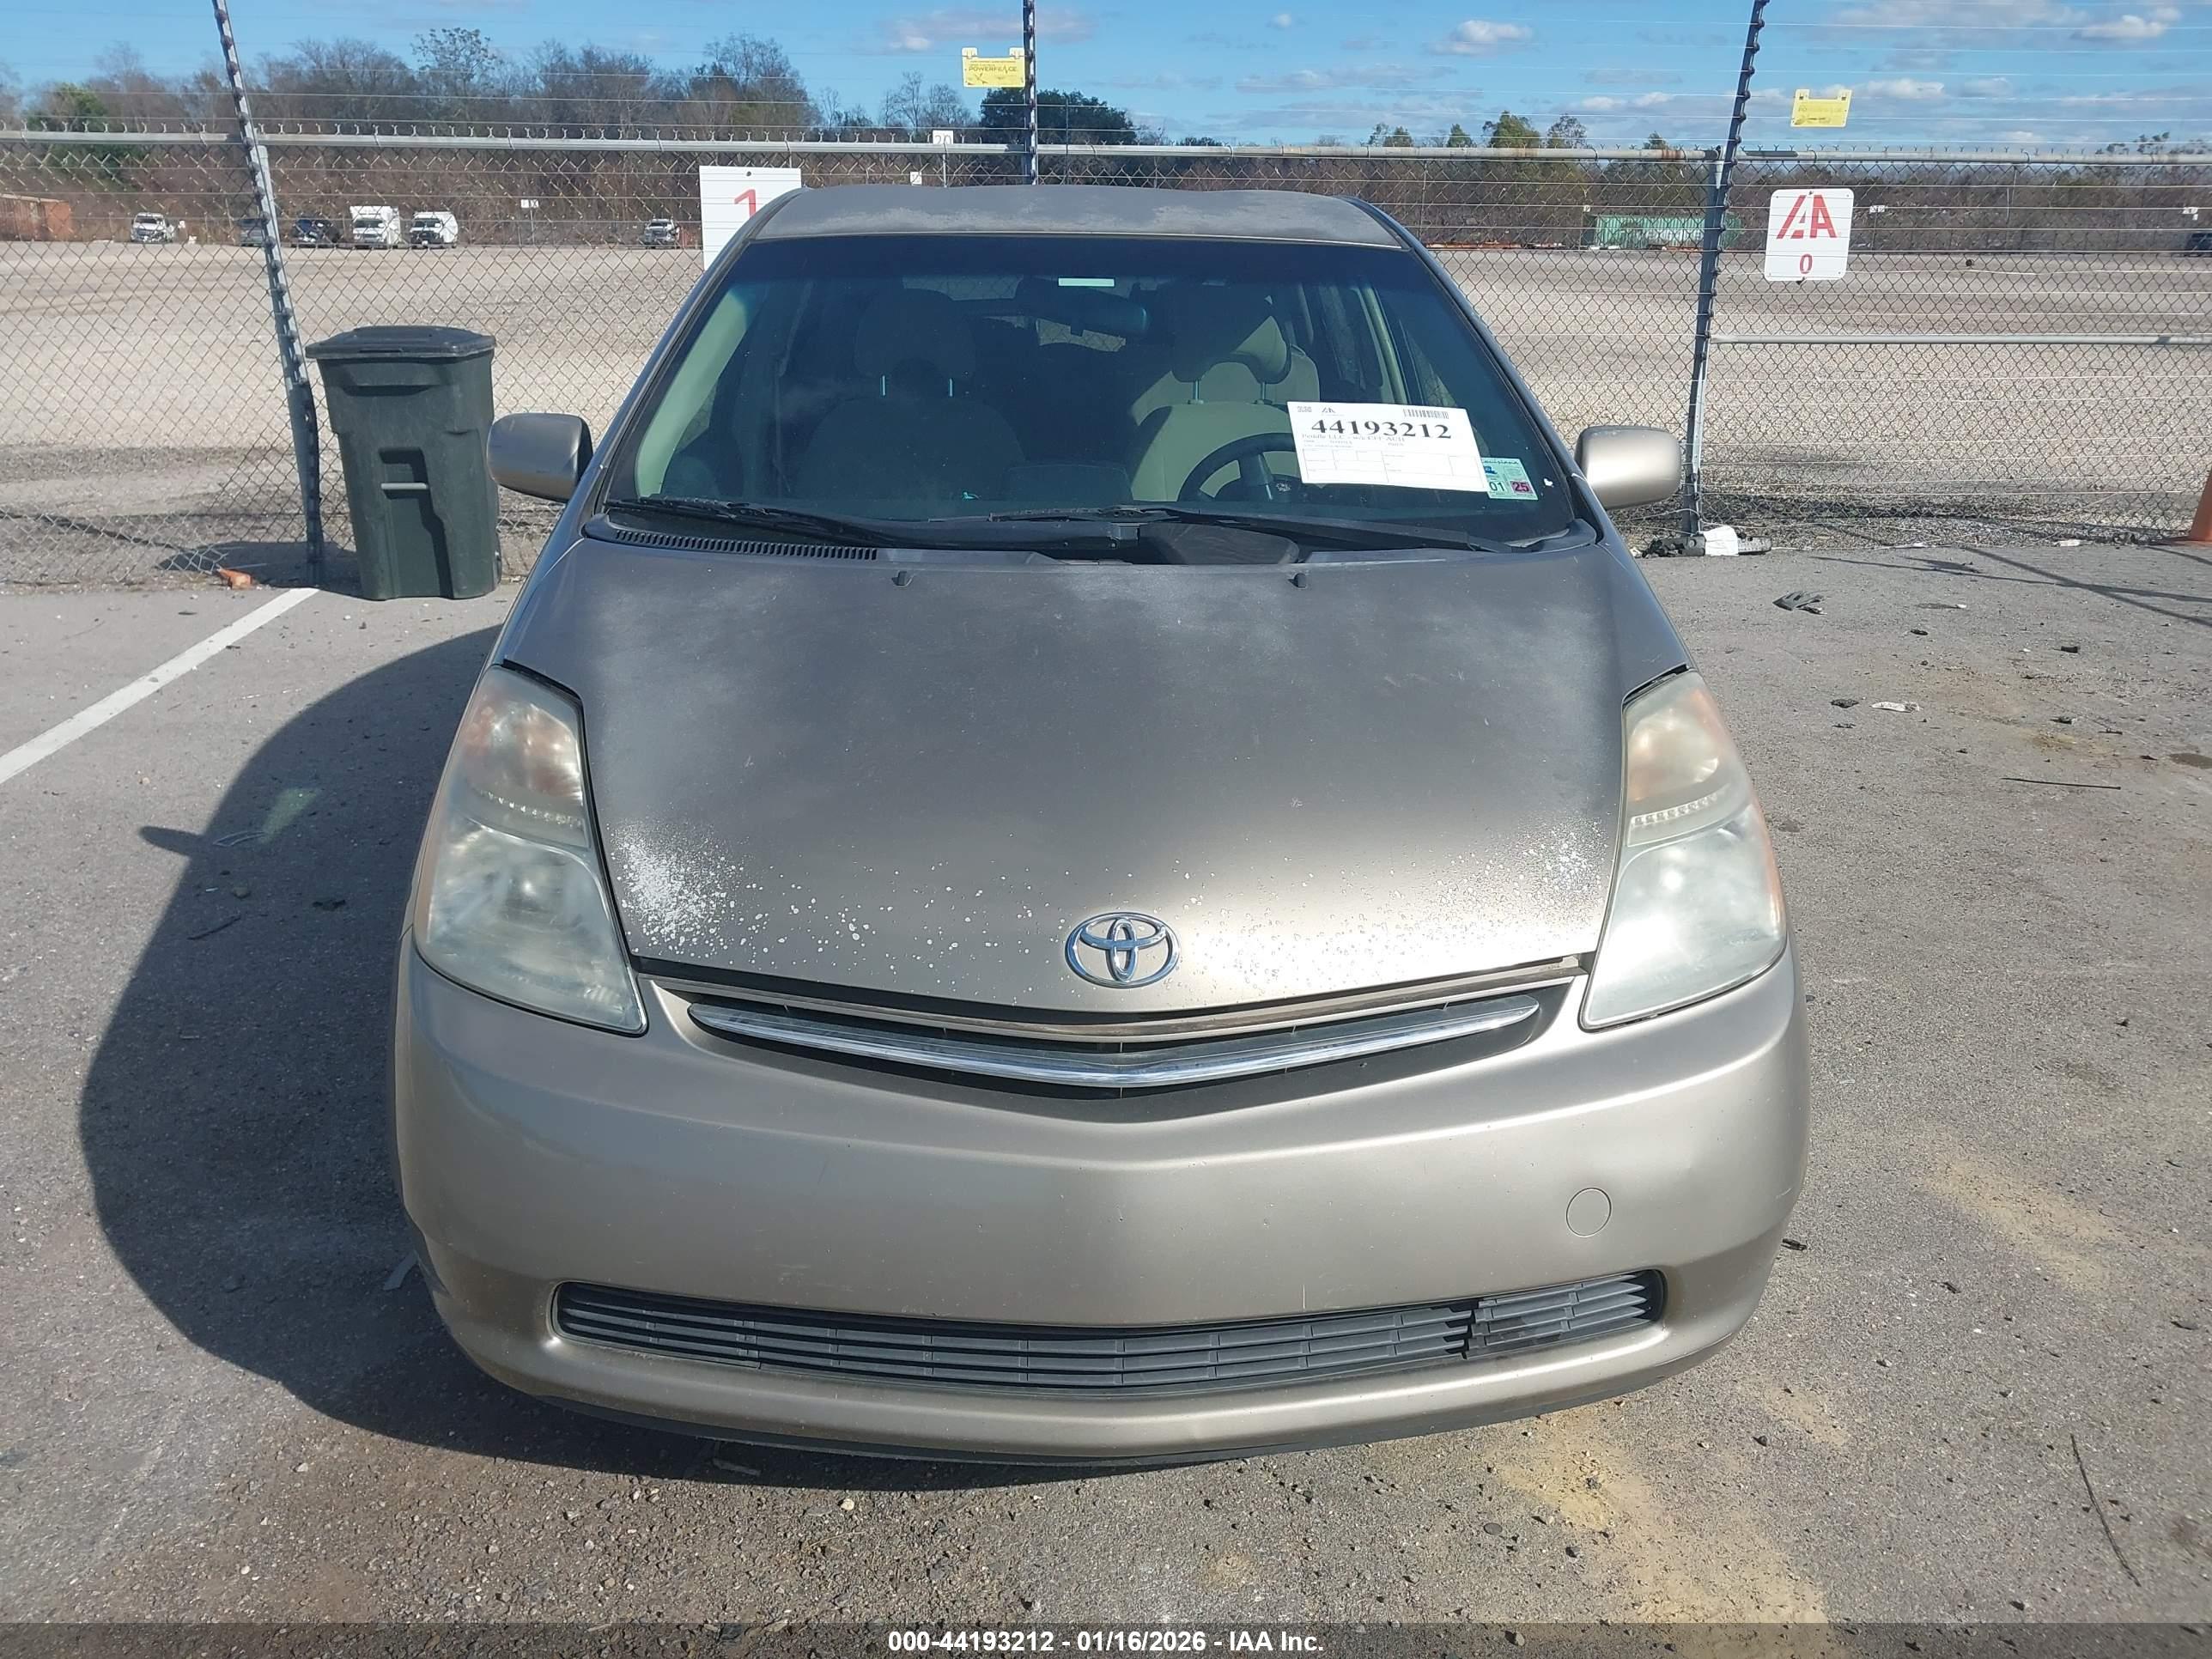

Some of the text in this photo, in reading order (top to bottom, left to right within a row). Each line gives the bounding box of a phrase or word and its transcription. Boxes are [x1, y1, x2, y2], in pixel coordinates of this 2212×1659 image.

[1799, 253, 1814, 275] 0
[1311, 419, 1452, 439] 44193212
[1489, 481, 1505, 491] 01
[1512, 482, 1530, 492] 25
